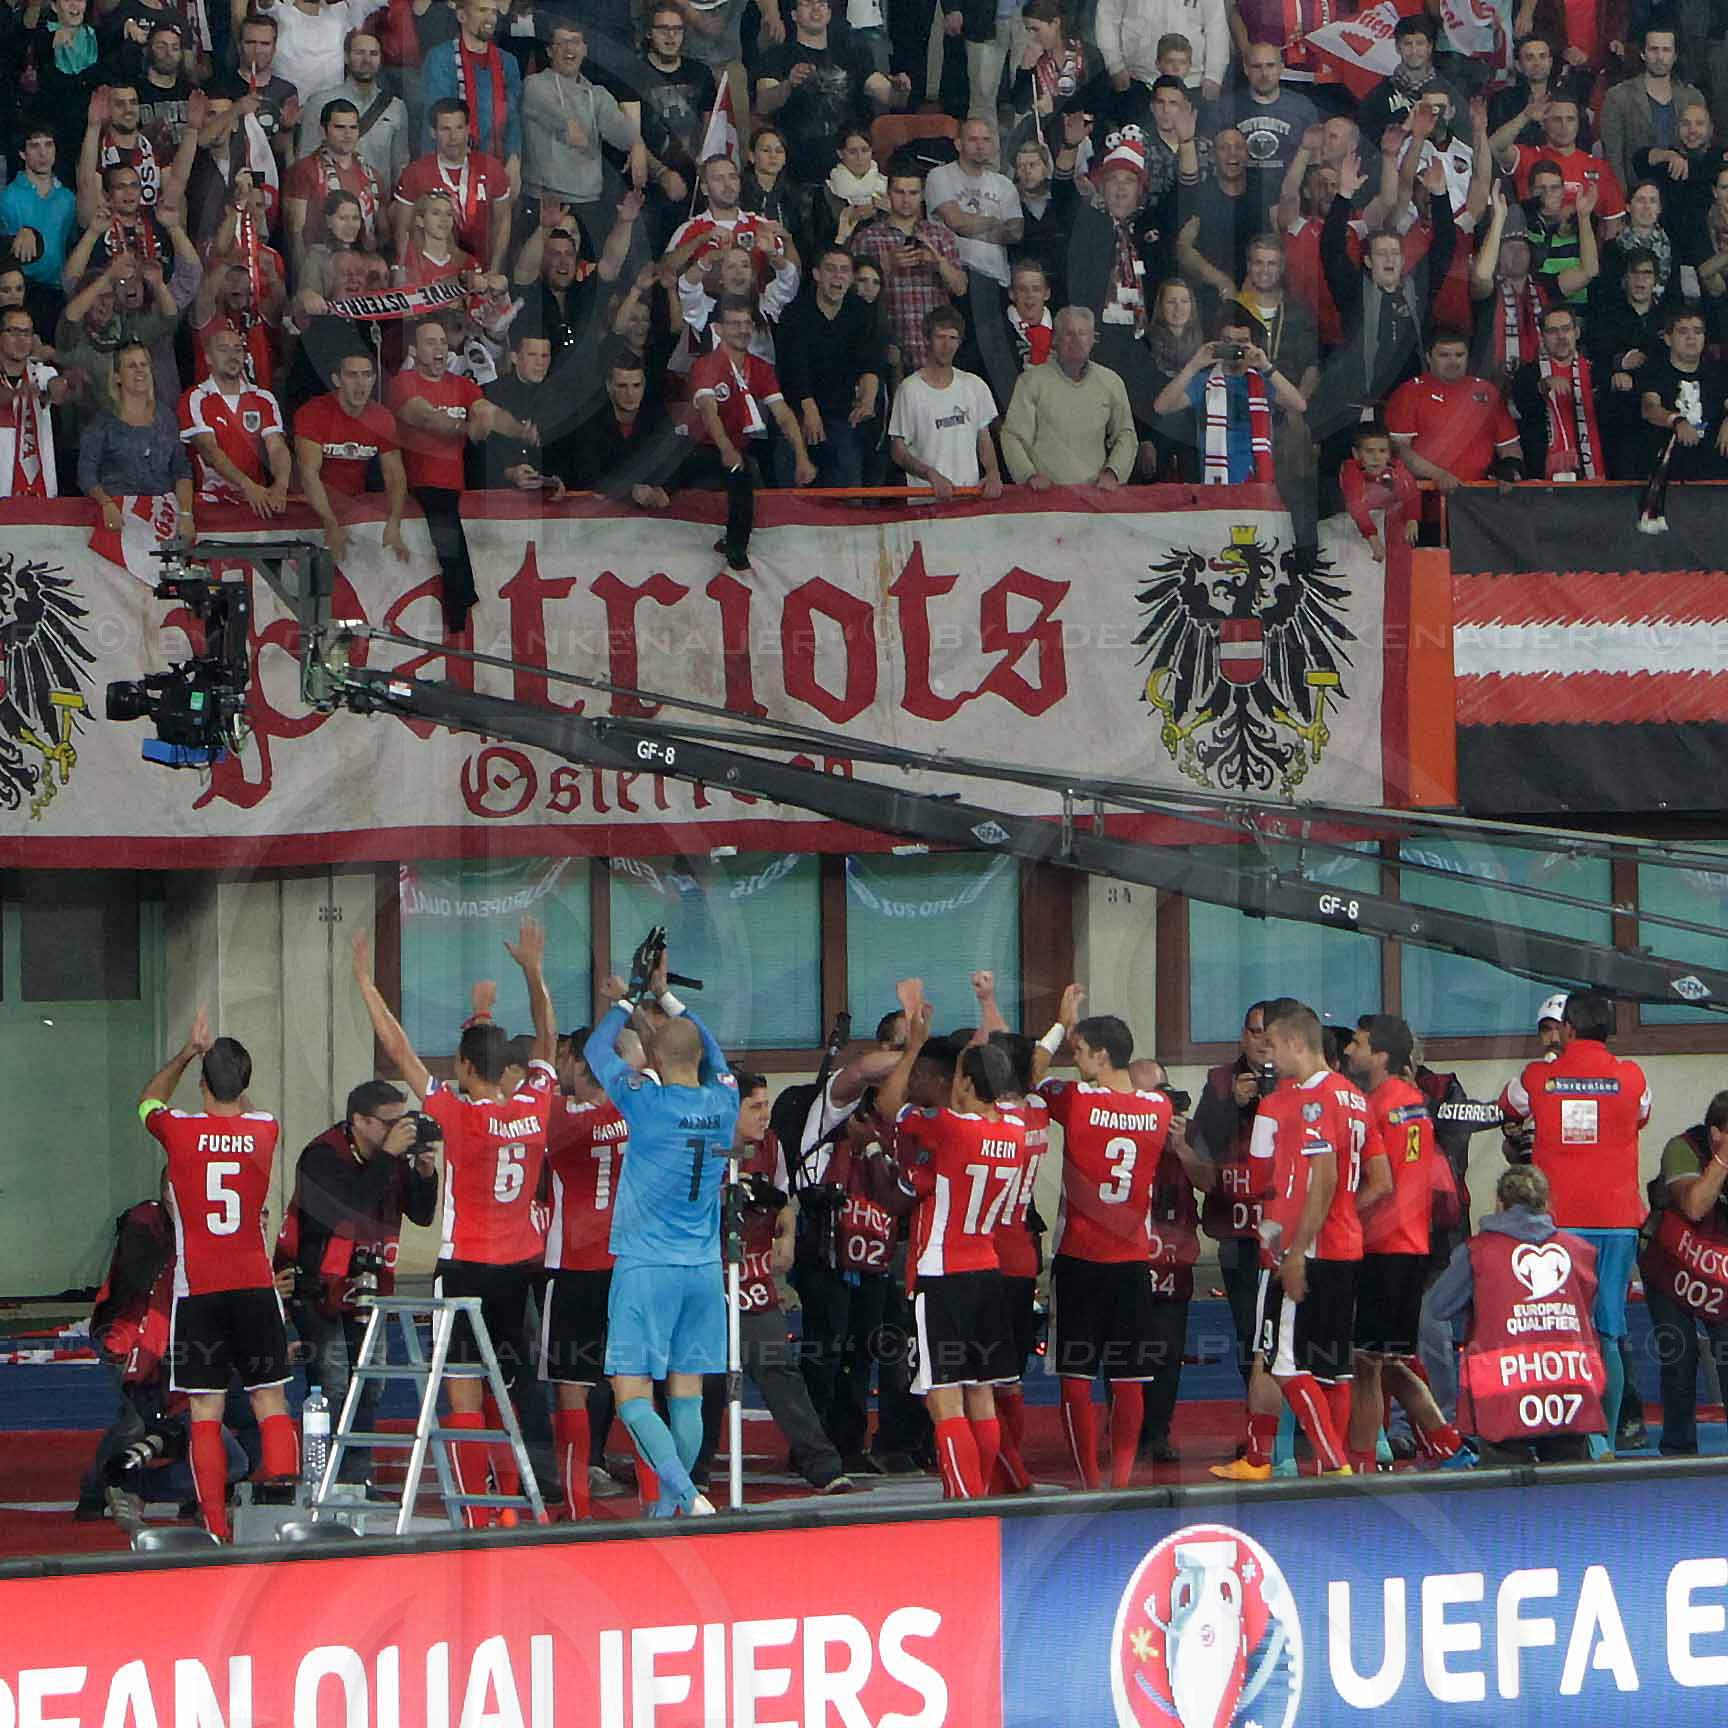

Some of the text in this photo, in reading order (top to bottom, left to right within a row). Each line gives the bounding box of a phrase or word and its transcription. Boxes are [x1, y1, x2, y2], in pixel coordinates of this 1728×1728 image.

[636, 739, 676, 765] GF-8
[1319, 894, 1359, 920] GF-8
[1089, 1108, 1158, 1132] DRAGOVIC
[198, 1134, 255, 1153] FUCHS
[980, 1138, 1017, 1159] KLEIN
[494, 1142, 525, 1204] 6
[685, 1138, 707, 1202] 1
[1098, 1137, 1137, 1204] 3
[205, 1161, 241, 1235] 5
[1513, 1304, 1576, 1318] EUROPEAN
[1673, 1270, 1726, 1315] 002
[1519, 1393, 1583, 1427] 007
[1327, 1564, 1640, 1710] UEFA
[292, 1604, 949, 1728] QUALIFIERS
